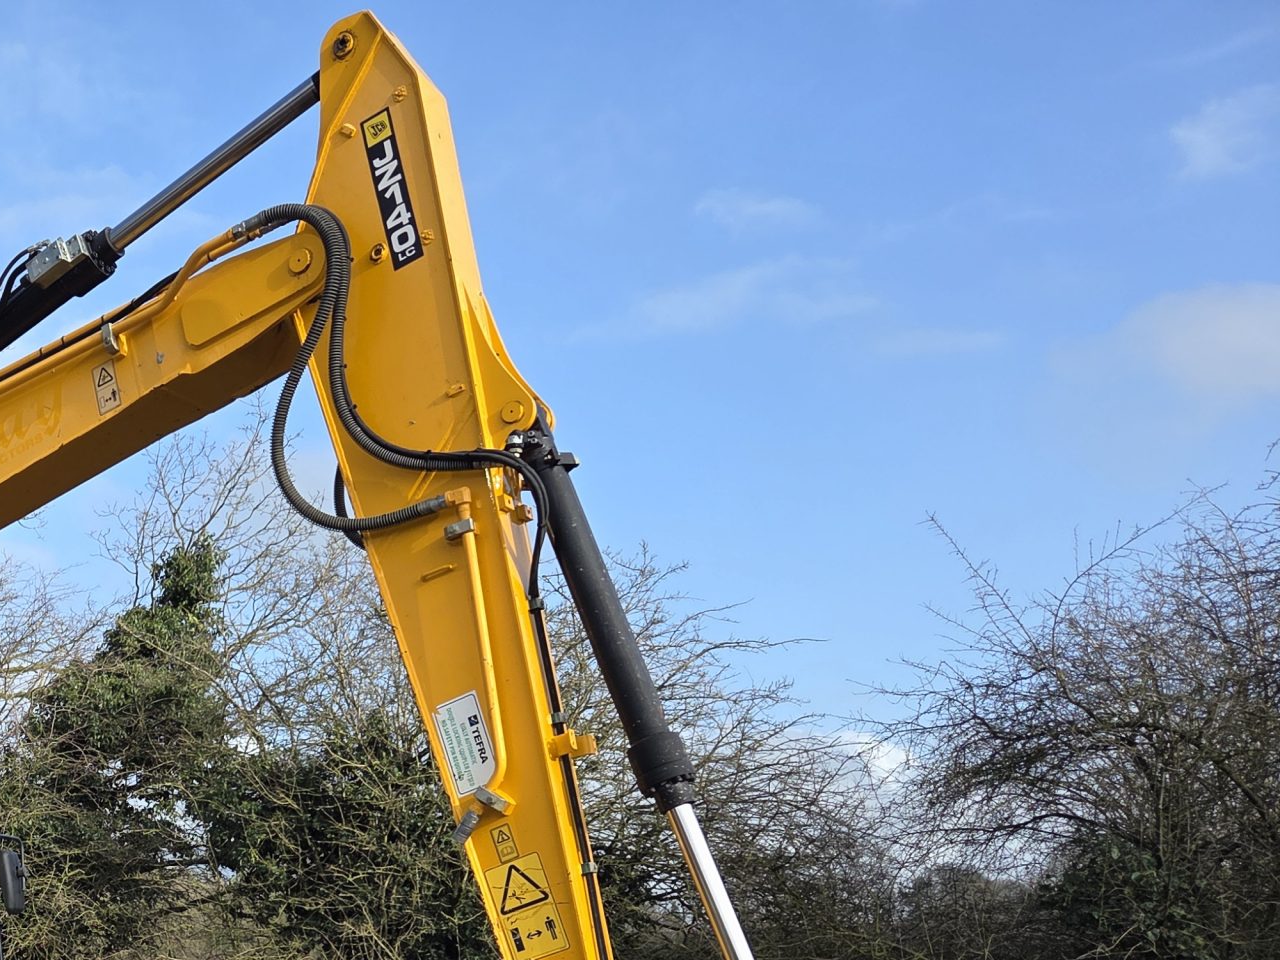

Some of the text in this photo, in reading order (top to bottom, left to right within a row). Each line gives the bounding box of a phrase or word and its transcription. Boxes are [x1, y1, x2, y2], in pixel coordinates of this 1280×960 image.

[371, 121, 387, 136] JCB
[398, 246, 416, 262] LC
[472, 727, 488, 764] TEFRA
